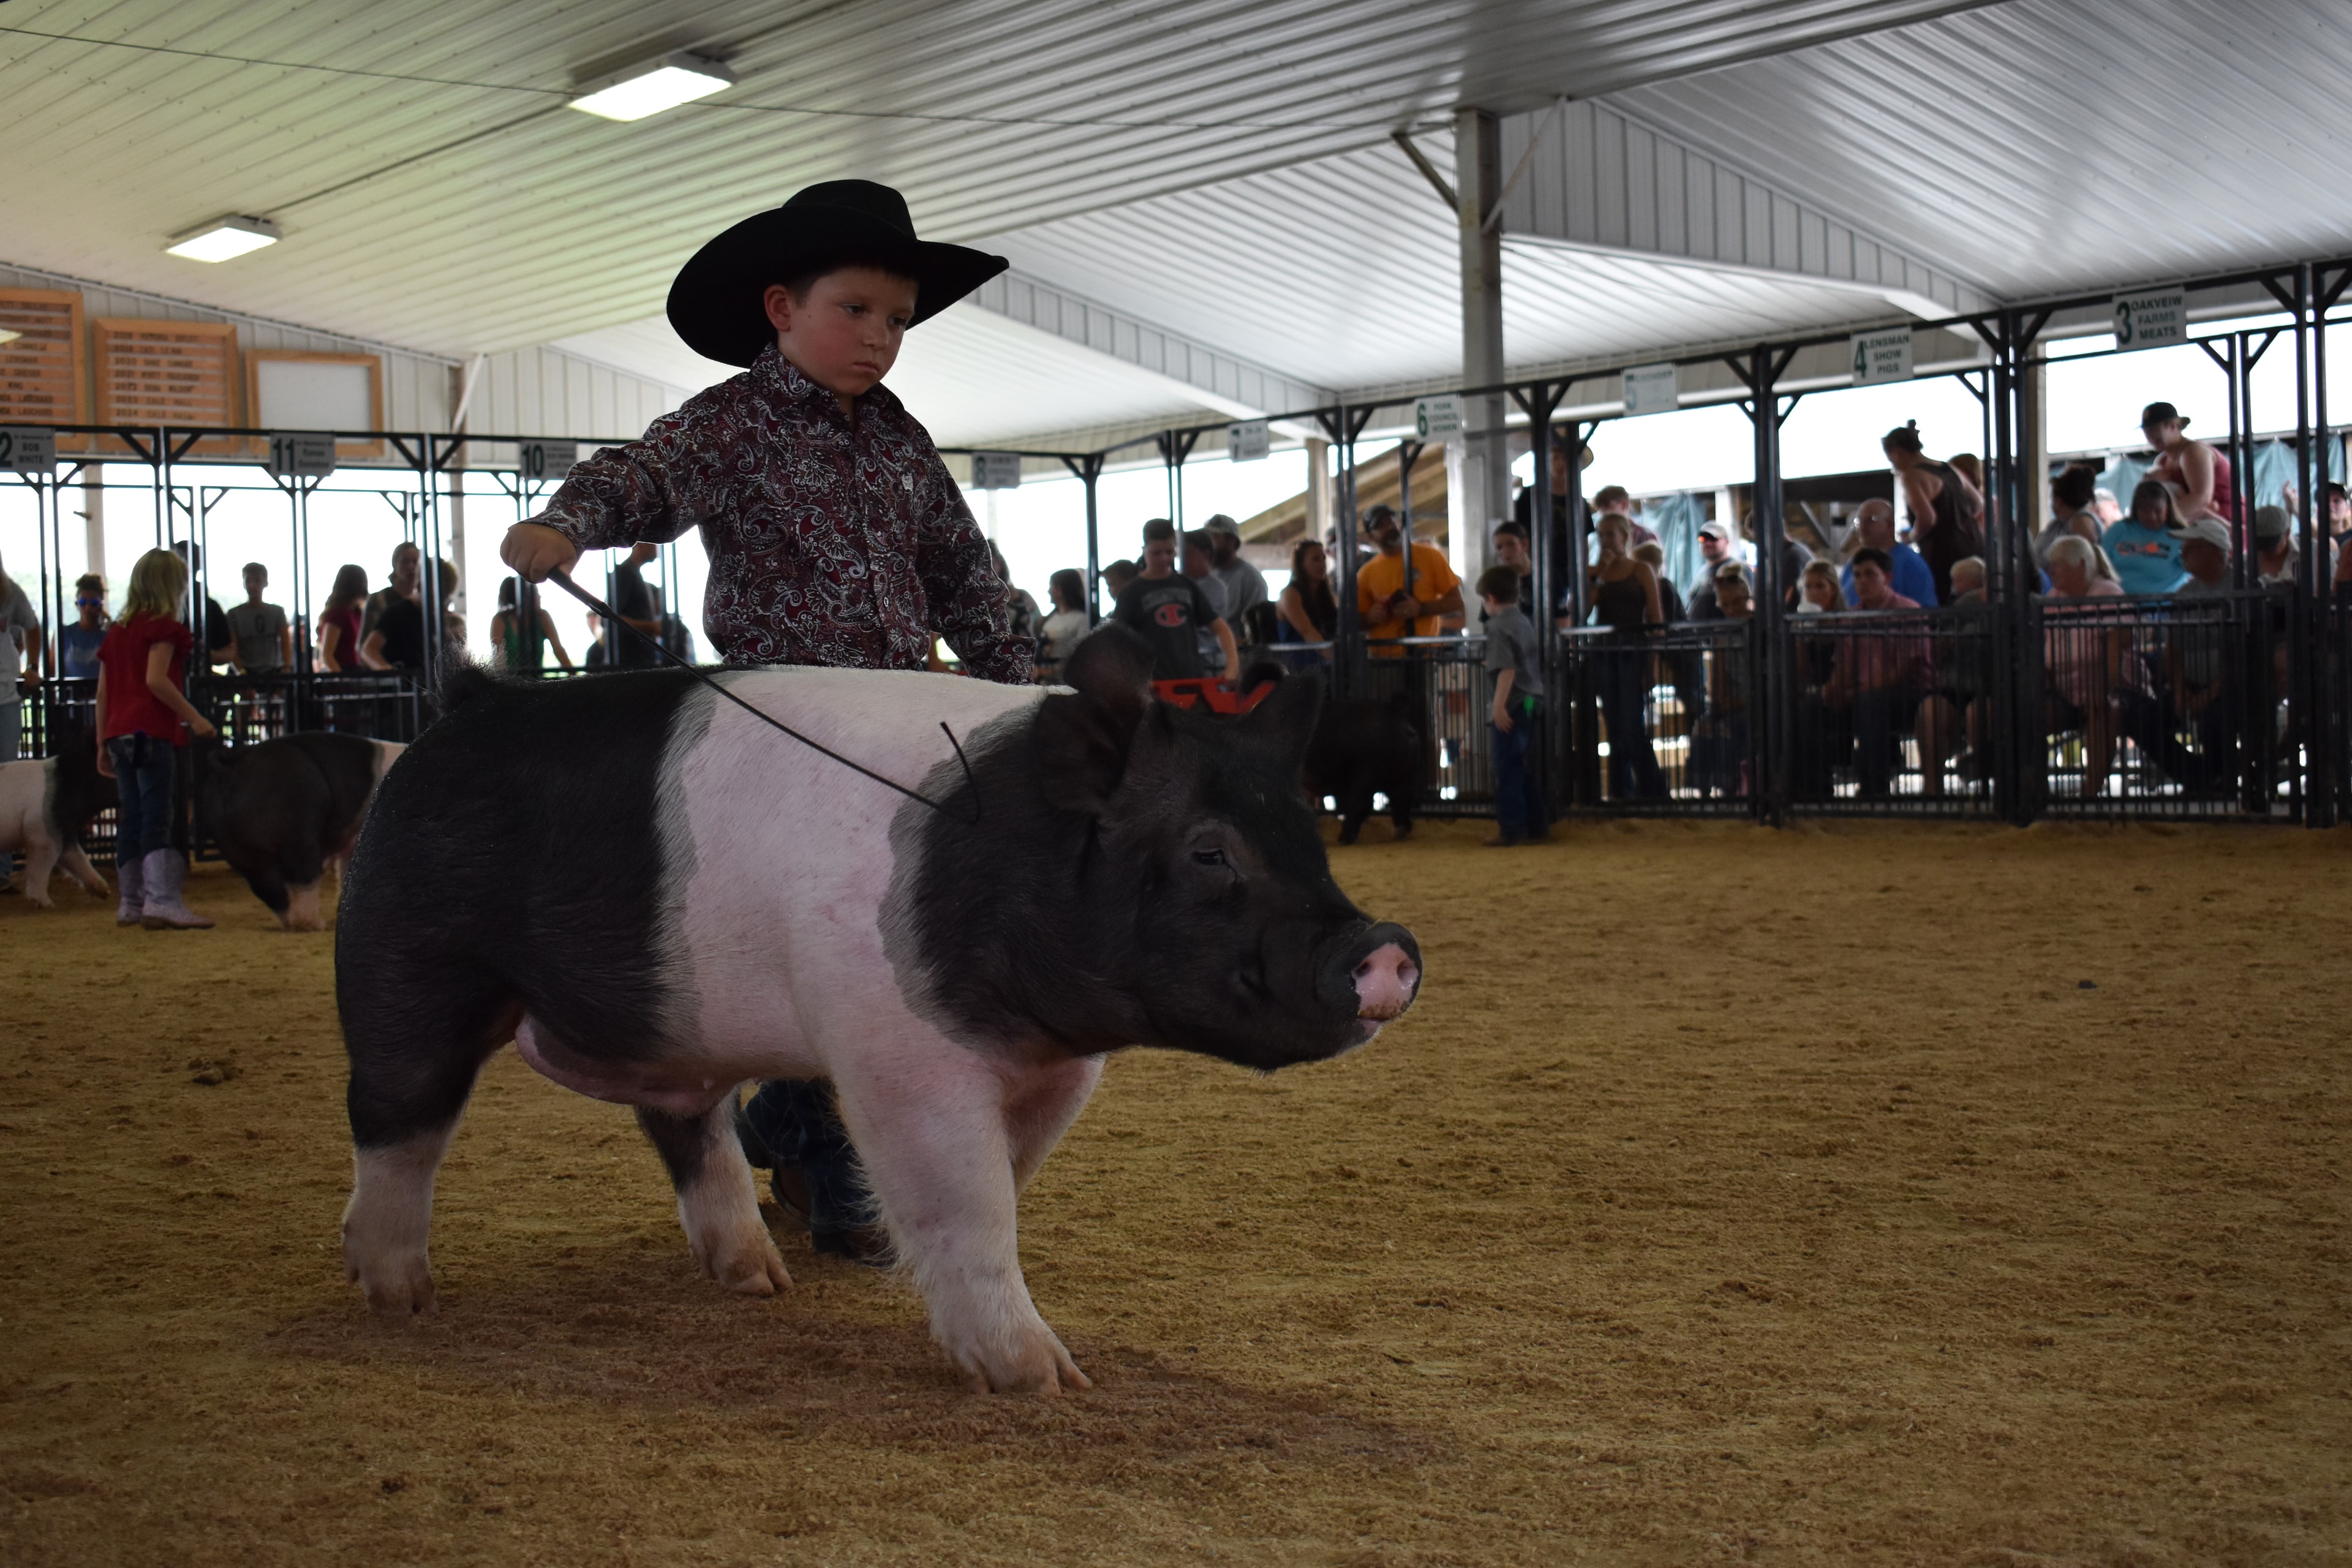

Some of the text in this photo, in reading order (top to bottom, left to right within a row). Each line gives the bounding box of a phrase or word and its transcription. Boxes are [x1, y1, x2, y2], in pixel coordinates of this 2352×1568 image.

[2132, 295, 2182, 311] OAKVEIW
[2116, 301, 2132, 344] 3
[2138, 311, 2176, 325] FARMS
[2139, 325, 2177, 339] MEATS
[1854, 340, 1866, 379] 4
[1874, 348, 1901, 361] SHOW
[1877, 363, 1899, 375] PIGS
[1417, 402, 1428, 437] 6
[1432, 423, 1457, 432] WOMEN
[23, 443, 40, 452] BOB
[273, 437, 294, 472] 11
[18, 455, 44, 464] WHITE
[521, 444, 543, 477] 10
[975, 455, 986, 486] 8
